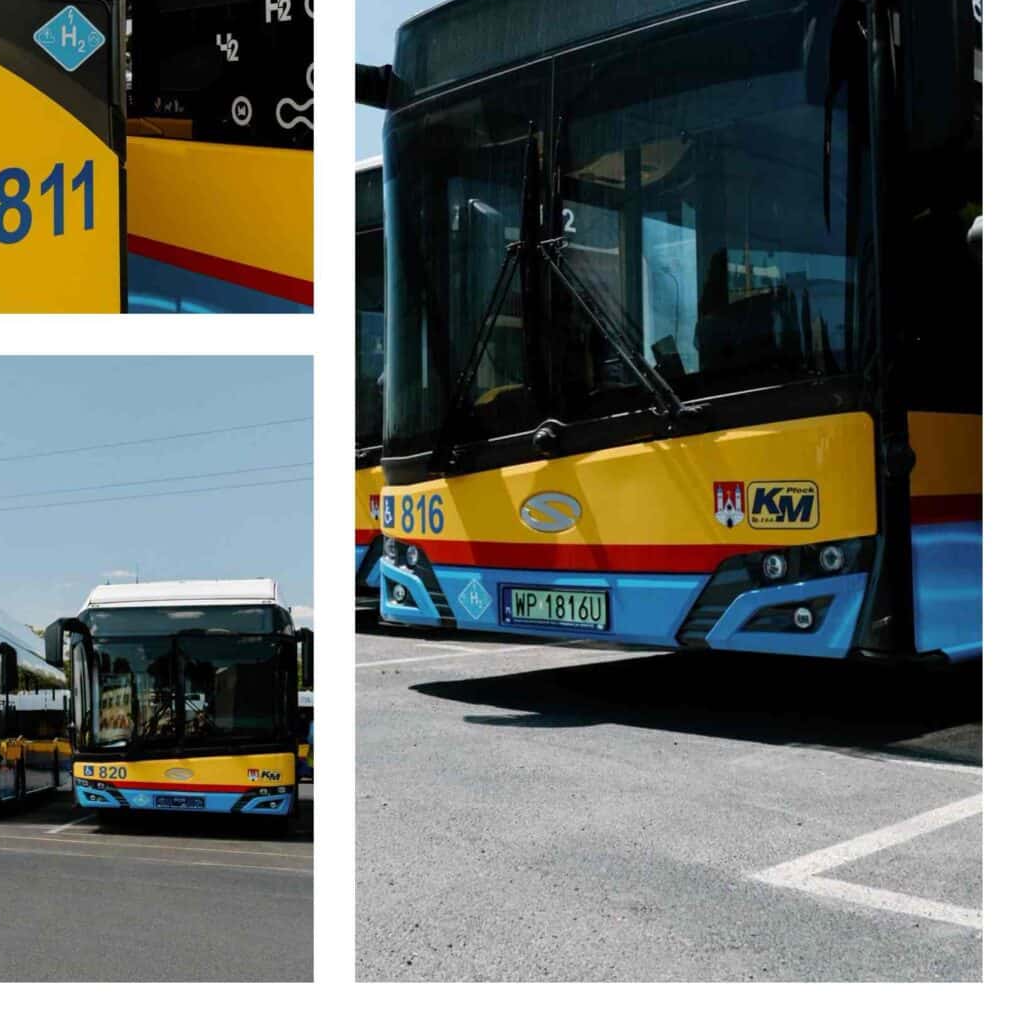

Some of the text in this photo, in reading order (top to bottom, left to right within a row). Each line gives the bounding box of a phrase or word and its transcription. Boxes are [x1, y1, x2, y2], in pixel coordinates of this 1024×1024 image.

[401, 494, 444, 534] 816
[752, 487, 815, 522] KM
[515, 592, 602, 621] WP 1816U
[99, 766, 127, 780] 820
[261, 770, 281, 781] KM
